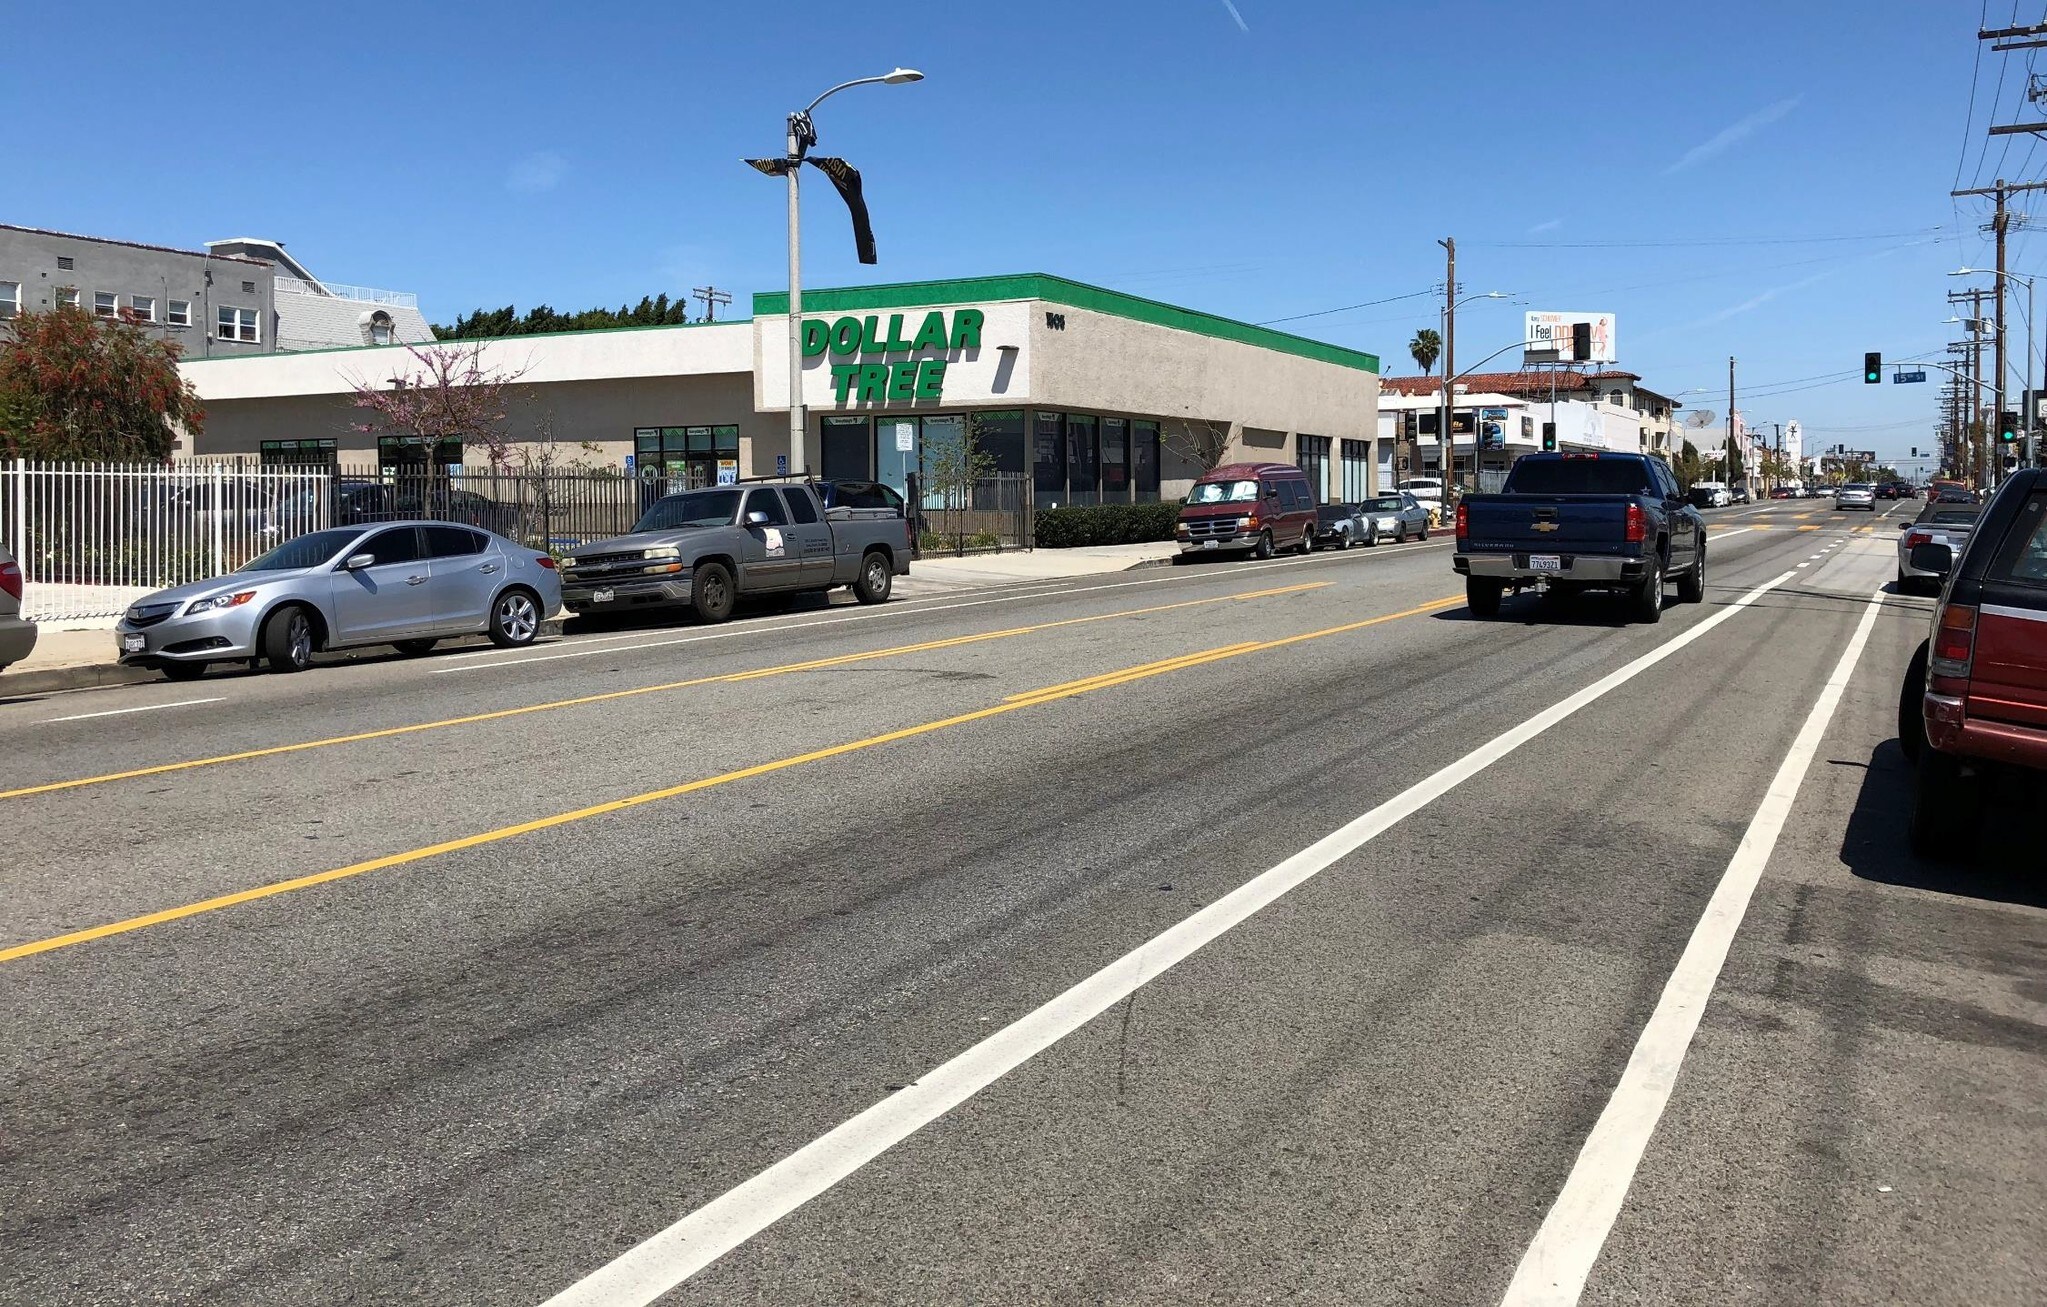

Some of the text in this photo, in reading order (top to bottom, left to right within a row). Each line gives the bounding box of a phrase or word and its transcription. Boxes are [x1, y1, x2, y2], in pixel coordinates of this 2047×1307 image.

[801, 309, 985, 357] DOLLAR
[1536, 325, 1552, 339] Feel
[831, 360, 948, 402] TREE
